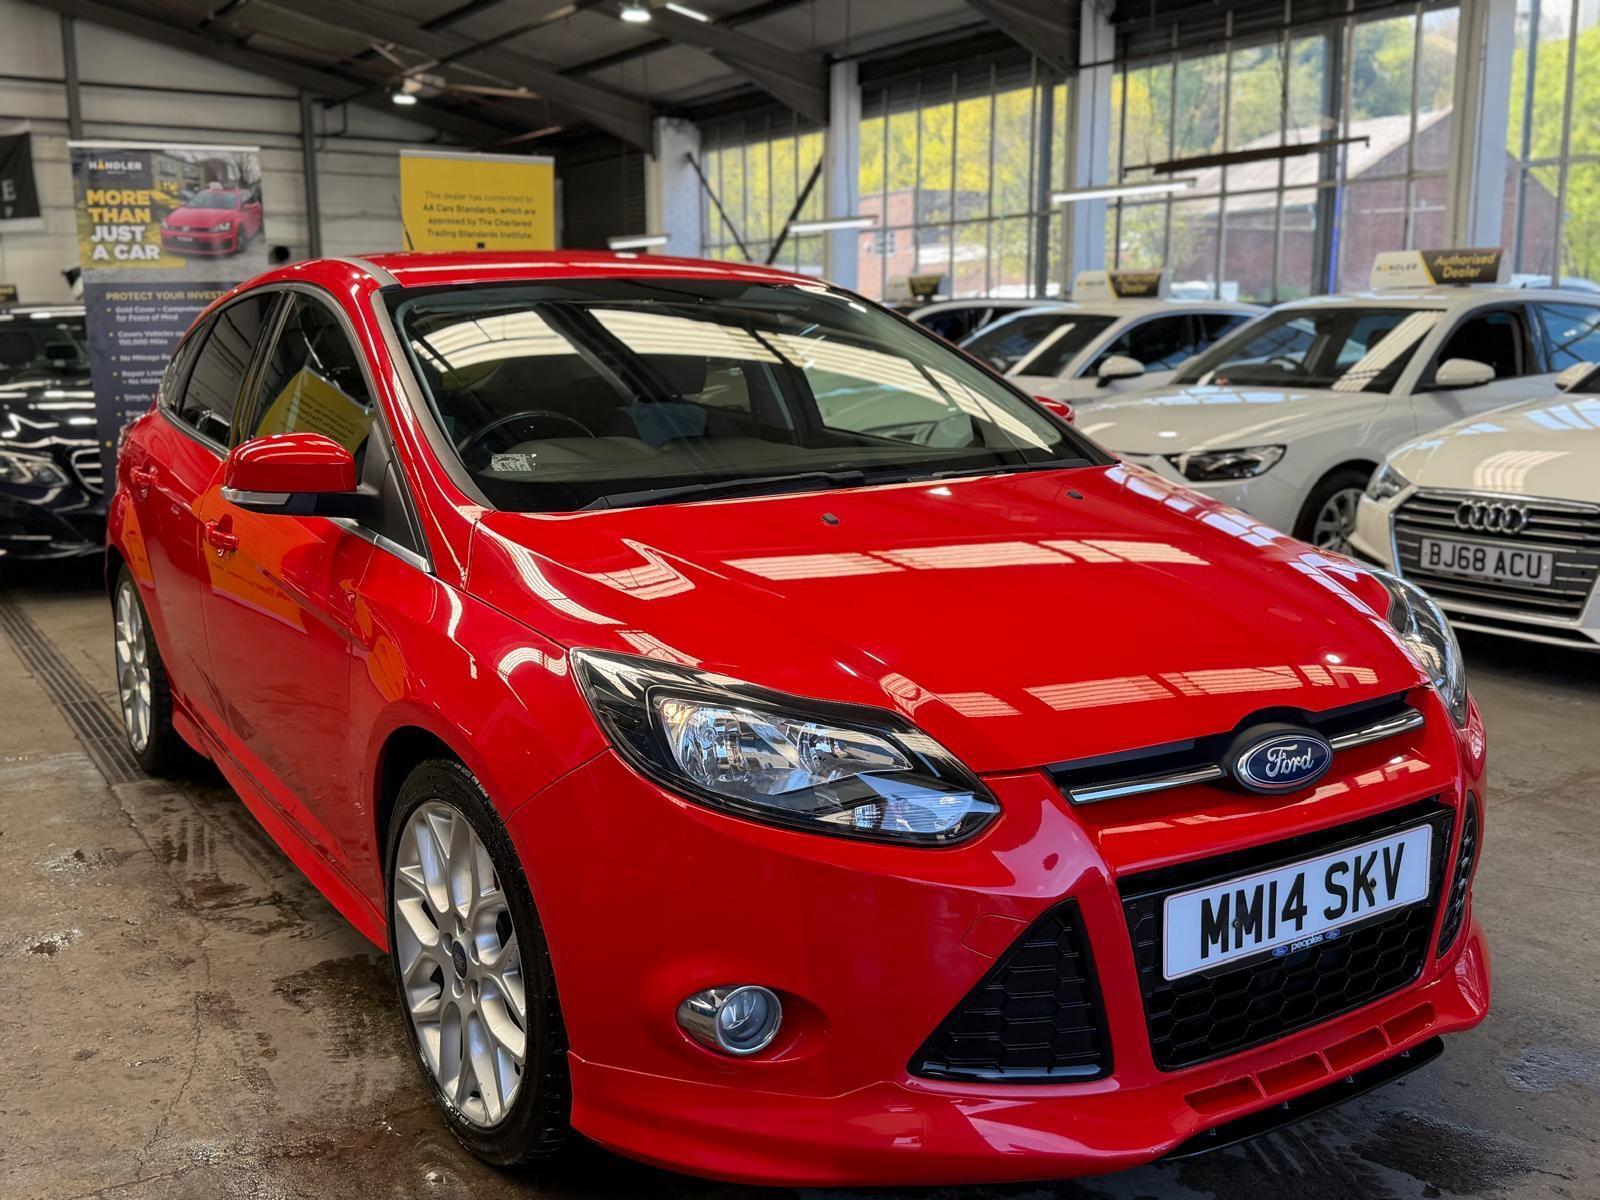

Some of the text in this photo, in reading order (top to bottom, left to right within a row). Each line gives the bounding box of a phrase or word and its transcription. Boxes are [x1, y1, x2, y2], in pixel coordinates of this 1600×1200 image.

[86, 190, 150, 205] MORE
[425, 191, 441, 199] This
[444, 191, 467, 200] dealer
[469, 192, 483, 200] has
[484, 194, 524, 203] committed
[88, 208, 150, 223] THAN
[423, 204, 434, 212] AA
[436, 205, 454, 213] Cars
[500, 208, 523, 216] which
[428, 217, 532, 228] approved by The Chartered
[91, 225, 145, 242] JUST
[427, 229, 456, 239] Trading
[458, 230, 498, 239] Standards
[92, 244, 160, 260] A CAR
[1443, 266, 1480, 278] Dealer
[105, 291, 153, 301] PROTECT
[155, 291, 184, 300] YOUR
[1429, 542, 1542, 579] BJ68 ACU
[1265, 744, 1313, 778] Ford
[1200, 842, 1405, 960] MM14 SKV
[1291, 933, 1324, 952] peoples
